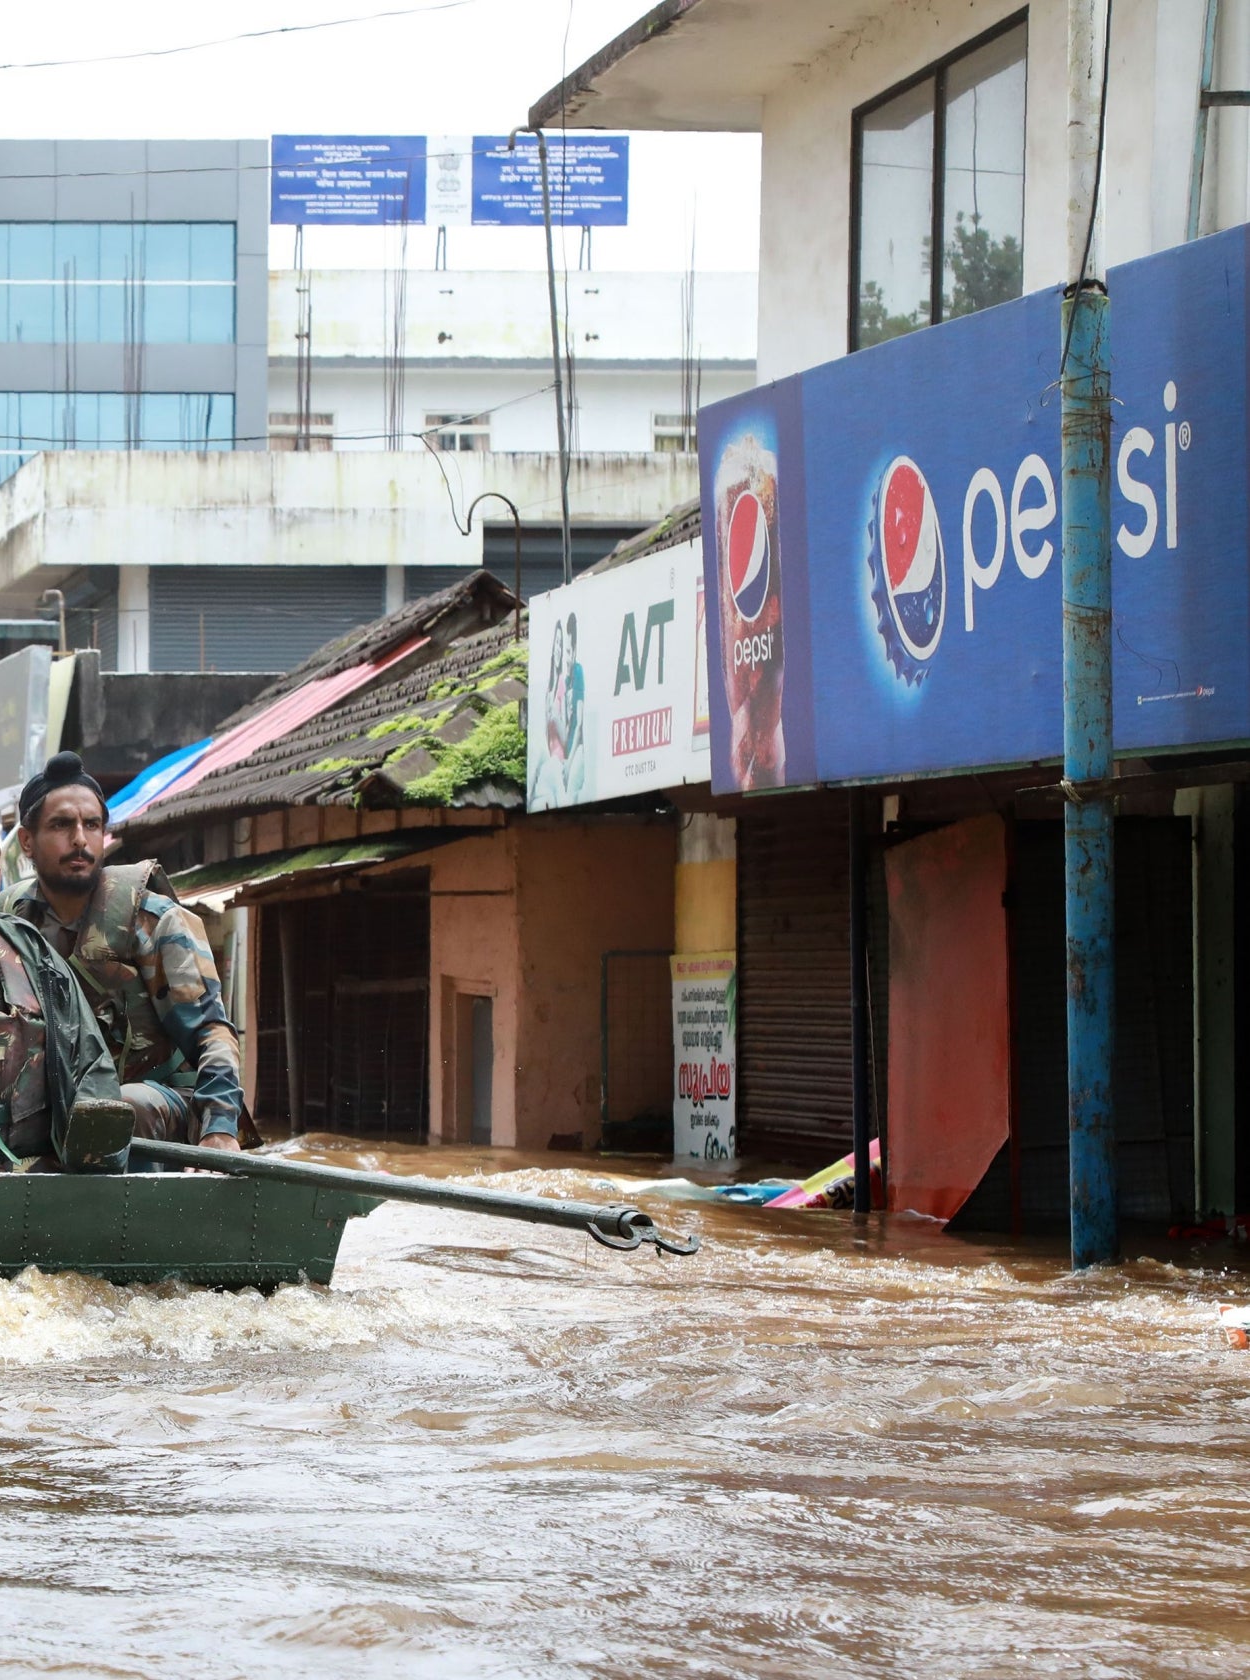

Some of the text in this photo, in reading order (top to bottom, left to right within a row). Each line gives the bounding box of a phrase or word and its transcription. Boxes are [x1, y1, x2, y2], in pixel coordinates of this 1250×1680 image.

[963, 380, 1179, 632] pesi
[614, 598, 675, 696] AVT
[734, 625, 772, 675] pepsi
[613, 709, 672, 754] PREMIUM
